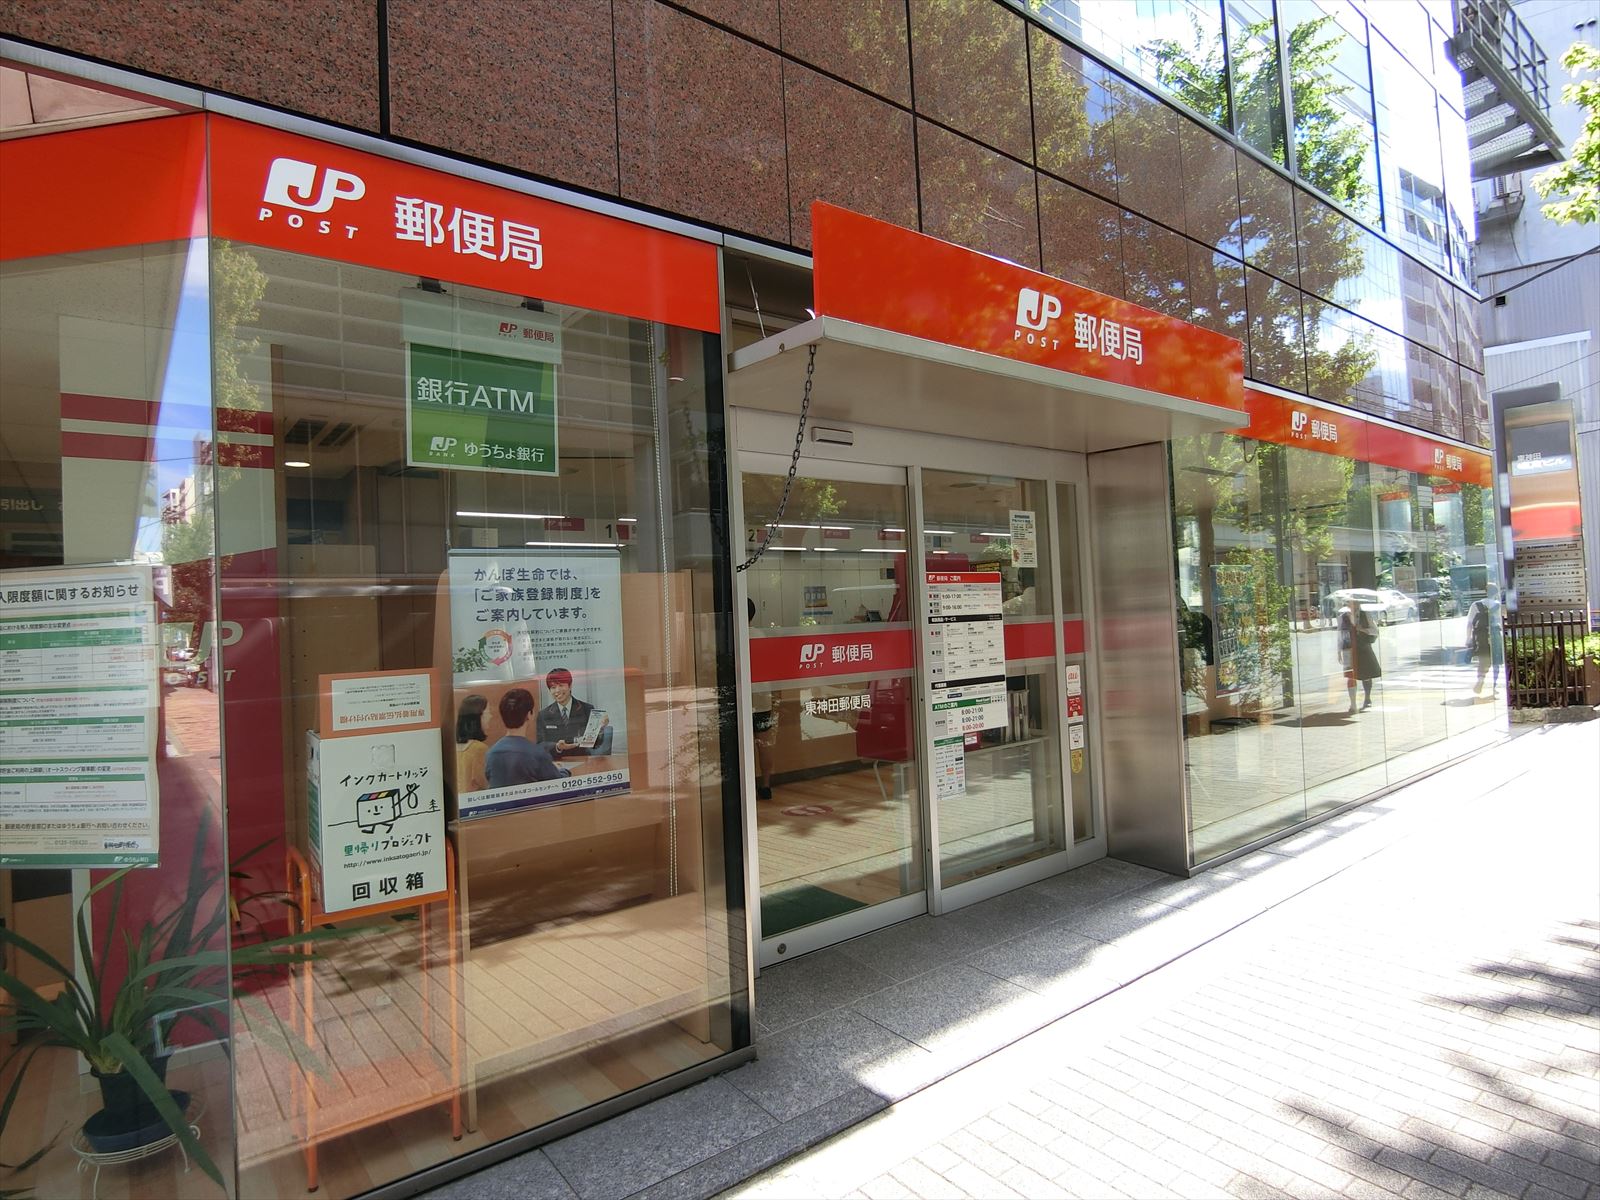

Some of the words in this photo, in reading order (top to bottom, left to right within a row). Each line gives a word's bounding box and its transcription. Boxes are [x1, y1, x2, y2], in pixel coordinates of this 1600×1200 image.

[259, 207, 359, 239] POST
[263, 157, 366, 213] JP
[394, 195, 543, 270] 郵便局
[522, 327, 555, 344] 郵便局
[1015, 287, 1062, 331] JP
[1073, 312, 1143, 366] 郵便局
[1014, 329, 1060, 351] POST
[417, 376, 535, 414] 銀行ATM
[1310, 418, 1338, 443] 郵便局
[463, 442, 545, 463] ゆうちょ銀行
[748, 529, 756, 542] 2
[473, 567, 580, 582] かんぽ生命では、
[474, 586, 602, 603] 「ご家族登録制度」を
[475, 605, 588, 622] ご案内しています。
[799, 643, 825, 663] JP
[831, 643, 873, 664] 郵便局
[804, 694, 871, 716] 東神田郵便局
[339, 766, 429, 787] インクカートリッジ
[561, 772, 624, 789] 0120-552-950
[343, 832, 432, 857] 里帰りプロジェクト
[343, 848, 432, 869] http://www.inksatogaeri.jp/
[352, 871, 424, 901] 回収箱
